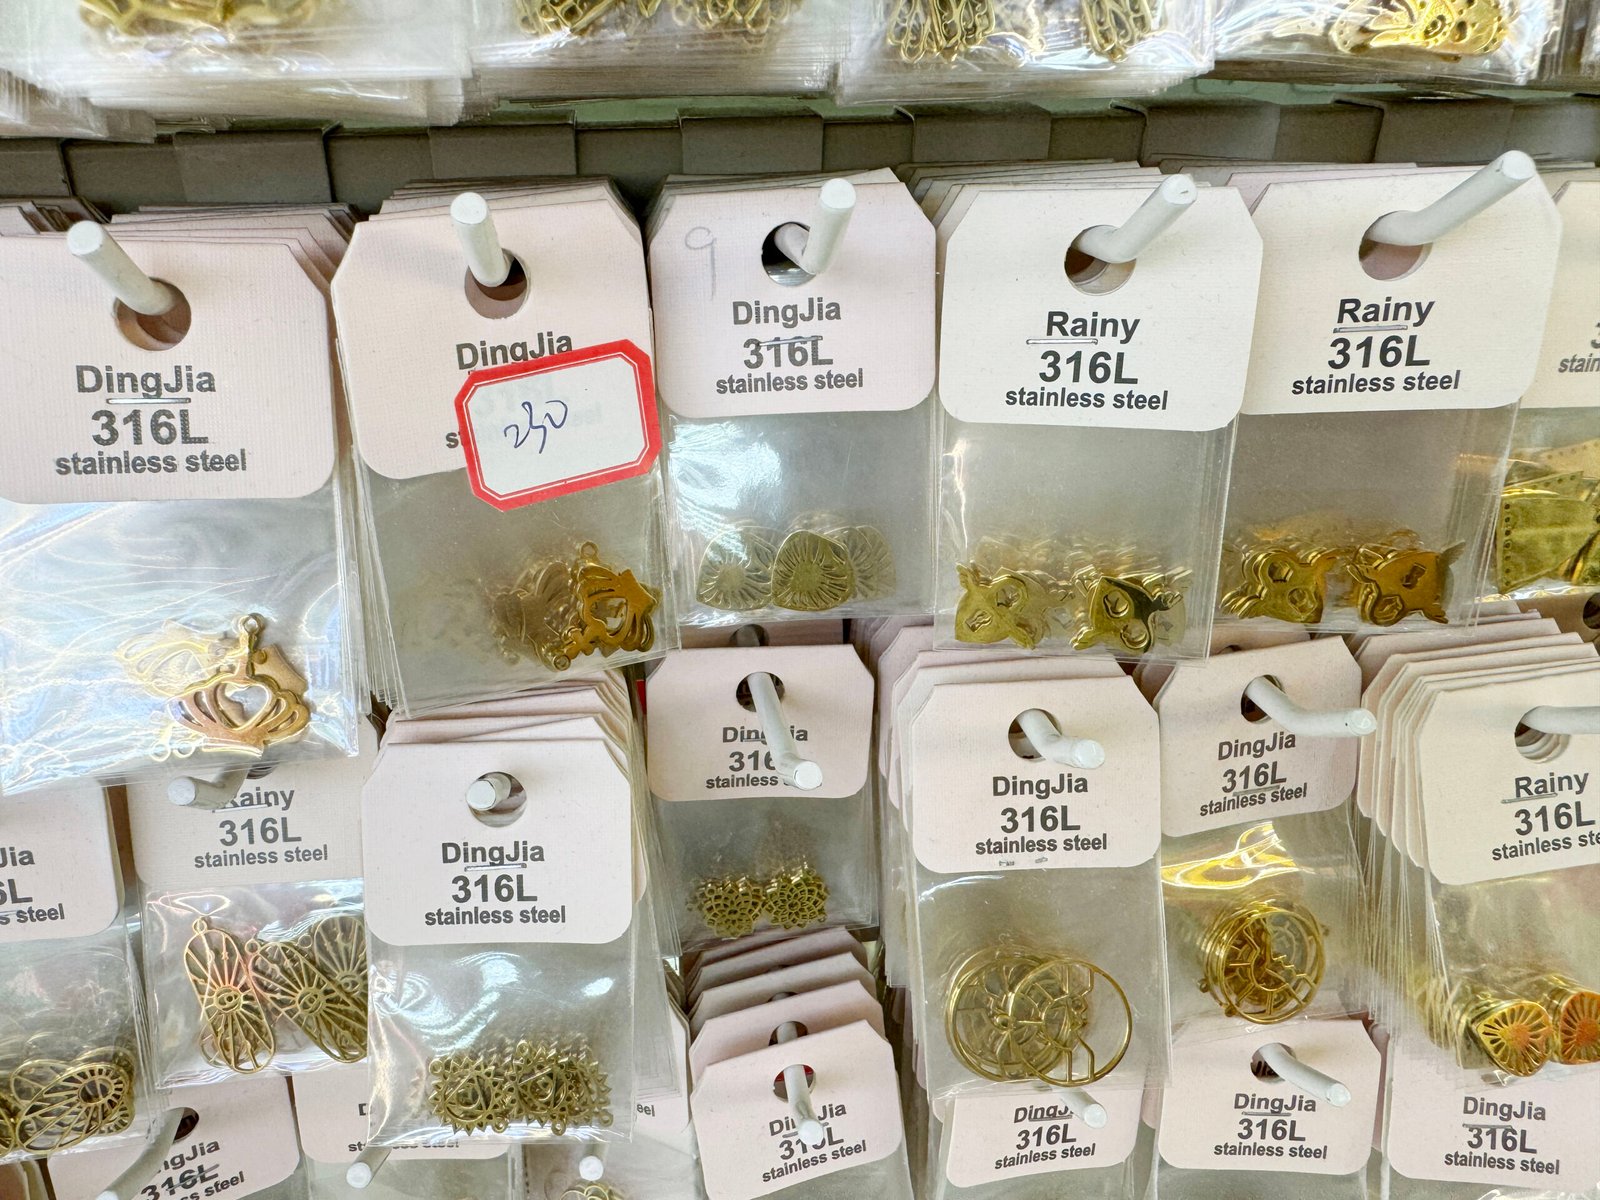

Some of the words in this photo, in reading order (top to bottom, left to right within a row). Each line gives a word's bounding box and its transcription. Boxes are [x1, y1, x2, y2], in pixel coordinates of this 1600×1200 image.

[685, 226, 716, 301] 9
[732, 297, 841, 328] DingJia
[1337, 296, 1435, 327] Rainy
[1046, 311, 1140, 344] Rainy
[743, 335, 833, 369] 316L
[1328, 335, 1430, 369] 316L
[1039, 350, 1138, 384] 316L
[76, 365, 216, 398] DingJia
[716, 372, 808, 394] stainless
[814, 368, 863, 389] steel
[1292, 373, 1395, 395] stainless
[1402, 370, 1461, 391] steel
[1005, 386, 1105, 408] stainless
[1113, 390, 1168, 410] steel
[92, 409, 208, 446] 316L
[56, 451, 177, 475] stainless
[185, 448, 247, 472] steel
[722, 725, 808, 746] Dinia
[1218, 731, 1296, 760] DingJia
[705, 774, 779, 789] stainless
[992, 773, 1088, 800] DingJia
[1221, 761, 1287, 793] 316L
[1515, 772, 1589, 798] Rainy
[230, 786, 295, 811] ainy
[1200, 794, 1266, 817] stainless
[1271, 782, 1308, 803] steel
[219, 817, 302, 846] 316L
[1000, 805, 1081, 833] 316L
[1514, 801, 1596, 836] 316L
[194, 852, 278, 868] stainless
[284, 844, 328, 862] steel
[442, 840, 545, 866] DingJia
[975, 836, 1058, 855] stainless
[1063, 833, 1107, 851] steel
[1492, 837, 1572, 861] stainless
[452, 874, 537, 903] 316L
[16, 903, 65, 924] steel
[425, 906, 513, 926] stainless
[519, 905, 565, 924] steel
[1234, 1093, 1316, 1114] DingJia
[1462, 1096, 1546, 1121] DingJia
[1016, 1123, 1077, 1150] 316L
[1237, 1118, 1306, 1141] 316L
[1467, 1127, 1537, 1154] 316L
[762, 1153, 828, 1182] stainless
[831, 1139, 867, 1160] steel
[994, 1149, 1057, 1169] stainless
[1061, 1143, 1096, 1158] steel
[1213, 1142, 1284, 1157] stainless
[1288, 1144, 1328, 1160] steel
[1444, 1151, 1516, 1170] stainless
[1520, 1159, 1560, 1175] steel
[204, 1170, 245, 1197] steel
